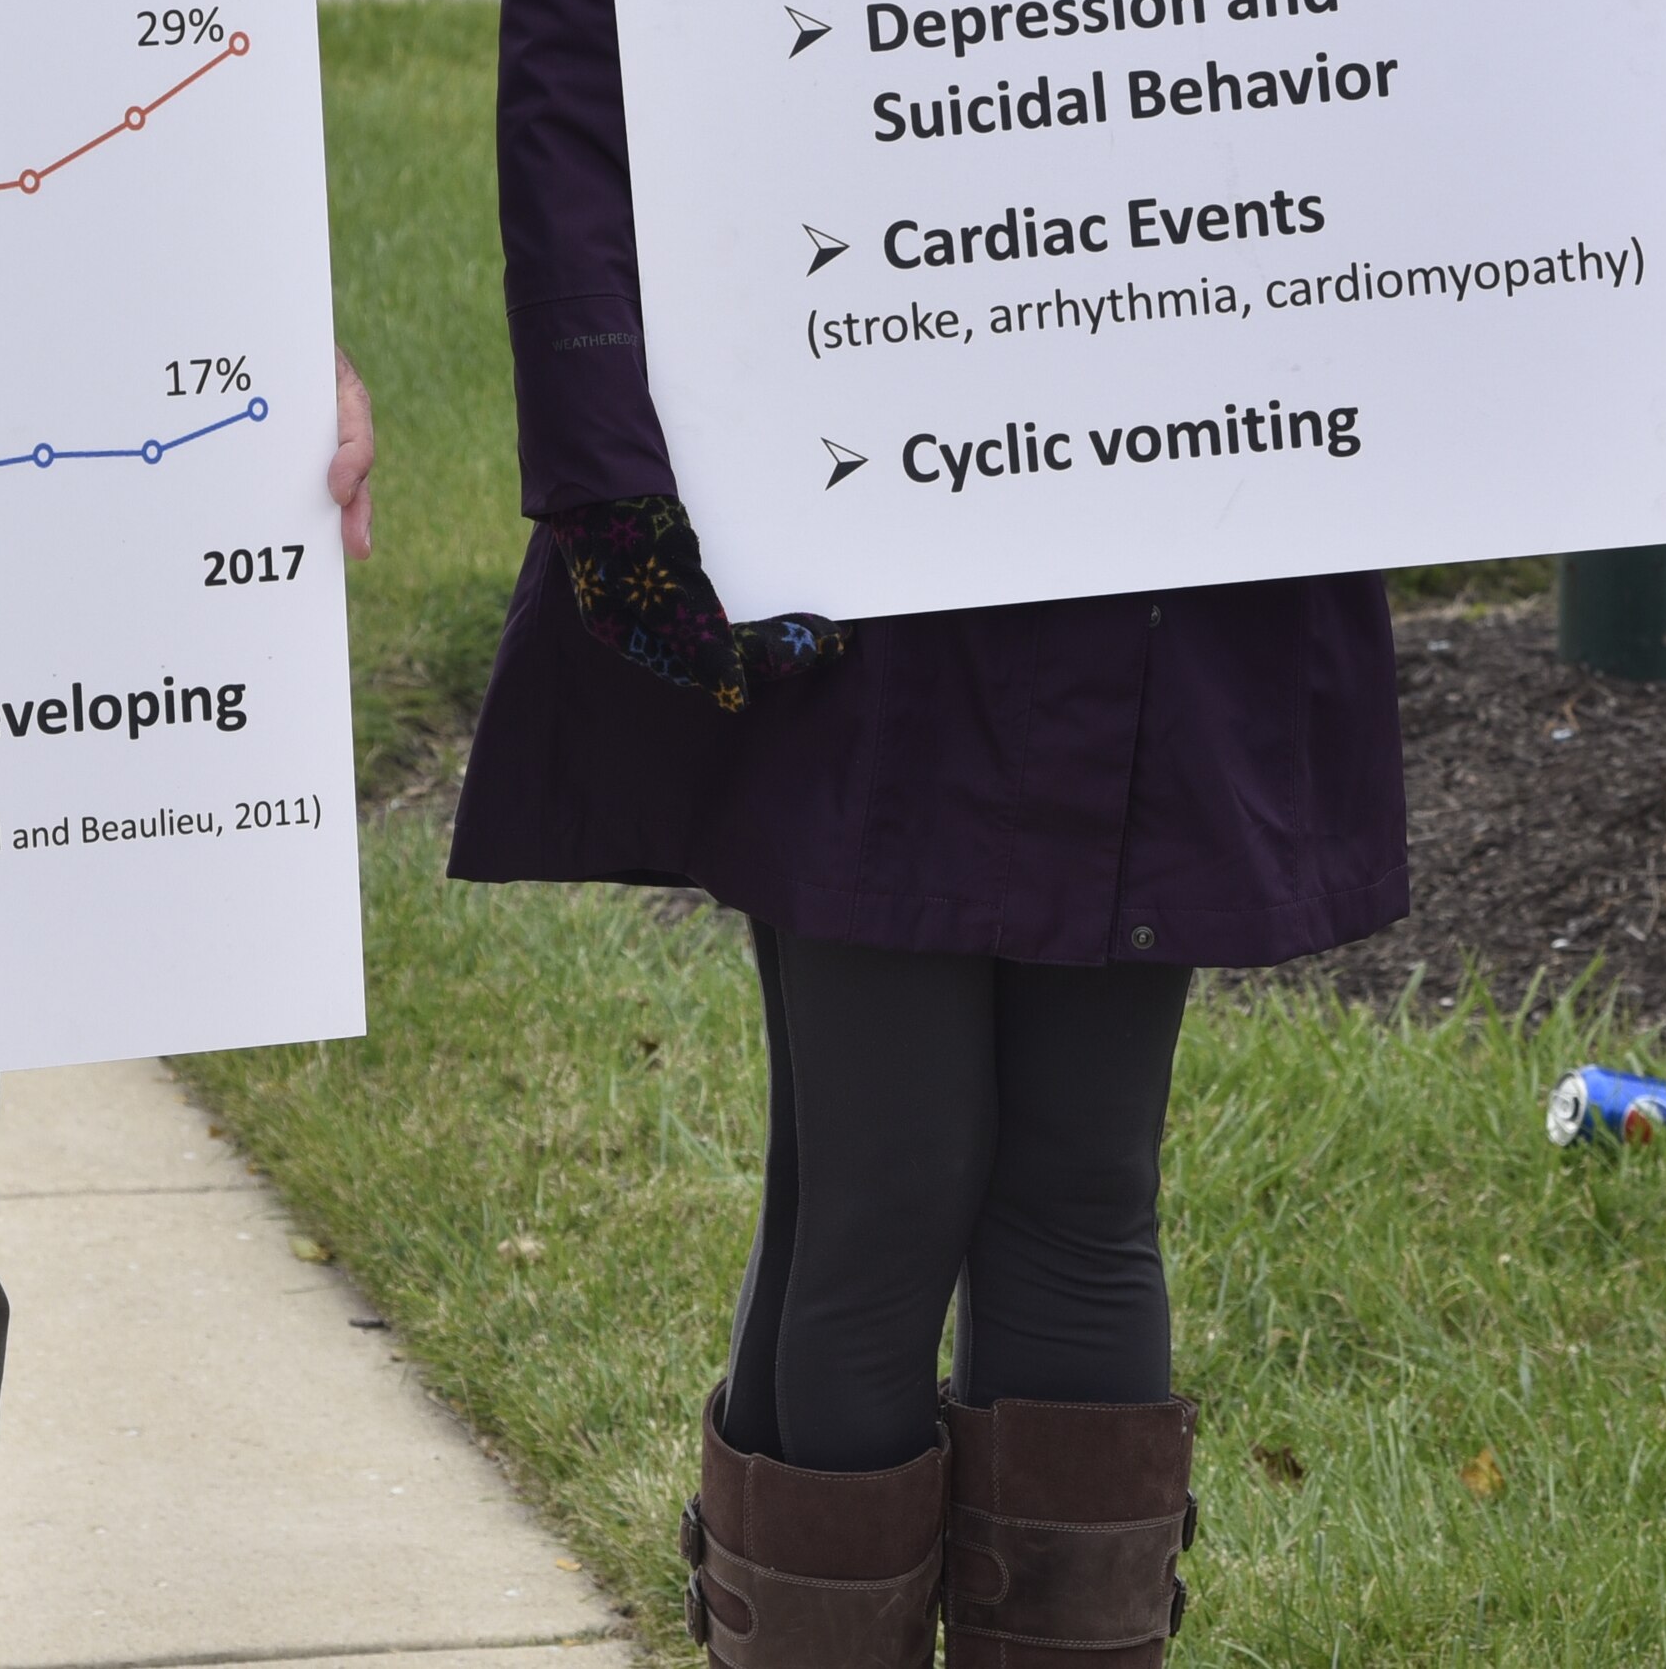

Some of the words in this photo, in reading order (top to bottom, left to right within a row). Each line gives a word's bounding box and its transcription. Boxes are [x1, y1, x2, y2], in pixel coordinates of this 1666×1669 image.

[136, 6, 224, 47] 29%
[873, 70, 1107, 143] Suicidal
[1128, 51, 1399, 120] Behavior
[883, 206, 1109, 270] Cardiac
[1127, 189, 1325, 249] Events
[807, 301, 973, 360] (stroke,
[989, 276, 1251, 335] arrhythmia,
[1266, 236, 1644, 309] cardiomyopathy)
[165, 355, 252, 397] 17%
[902, 421, 1073, 493] Cyclic
[1088, 399, 1362, 466] vomiting
[203, 544, 305, 587] 2017
[12, 816, 70, 850] and
[81, 807, 223, 844] Beaulieu,
[235, 794, 321, 830] 2011)
